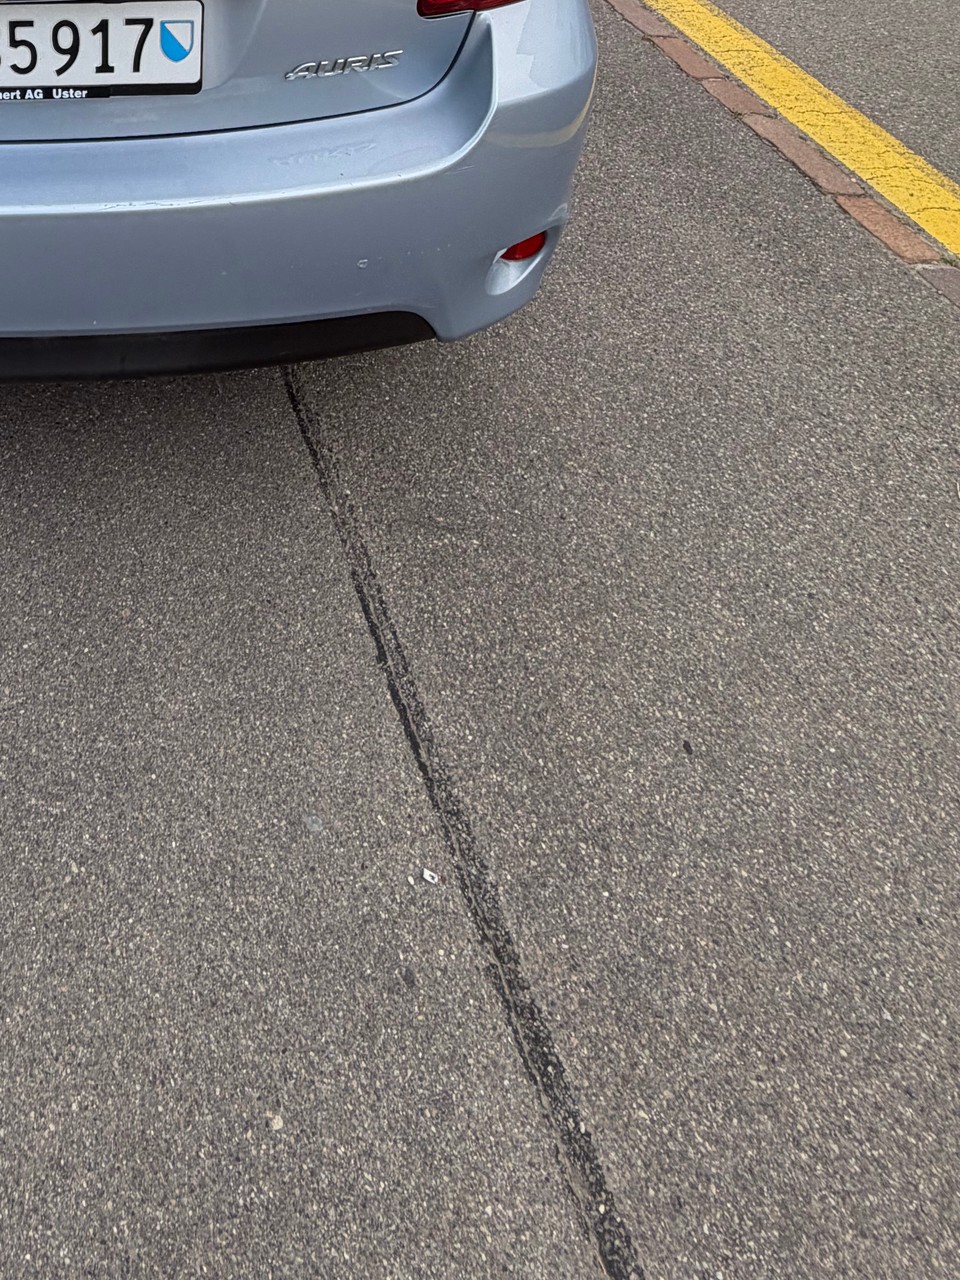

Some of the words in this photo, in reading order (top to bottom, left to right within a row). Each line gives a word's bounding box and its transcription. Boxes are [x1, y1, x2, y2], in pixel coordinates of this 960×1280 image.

[284, 49, 403, 80] AURIS
[25, 89, 44, 99] AG
[52, 88, 88, 99] Uster
